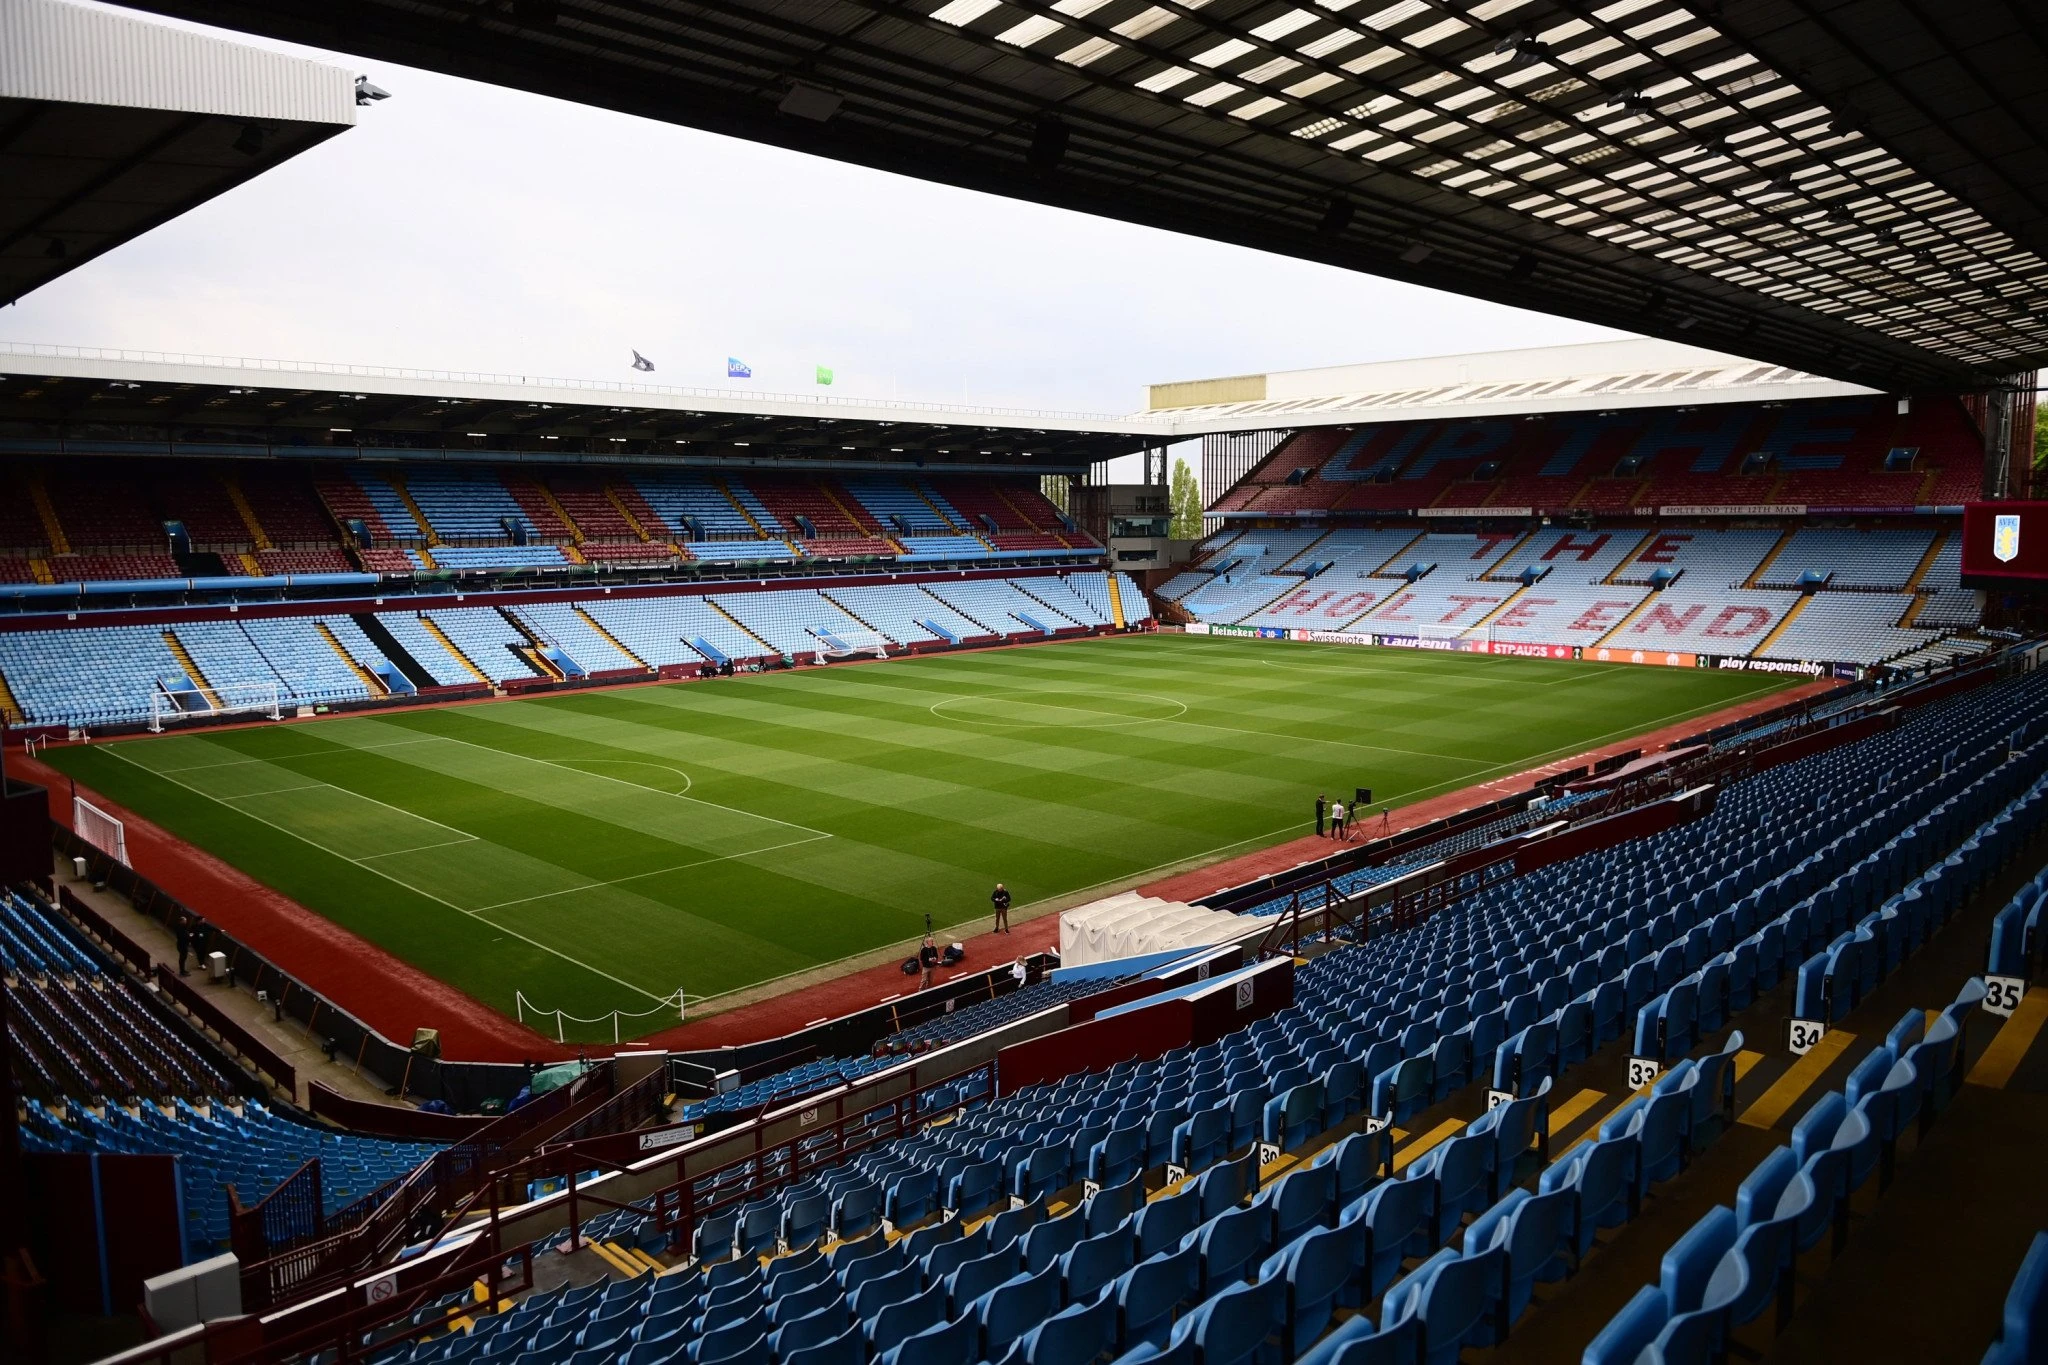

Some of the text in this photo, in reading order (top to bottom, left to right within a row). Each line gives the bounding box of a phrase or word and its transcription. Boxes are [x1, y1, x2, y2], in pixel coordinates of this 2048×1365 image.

[1452, 508, 1470, 516] THE
[1473, 507, 1523, 516] OBSESSION
[1634, 506, 1653, 516] 1888
[1666, 506, 1696, 514] HOLTE
[1700, 506, 1720, 514] END
[1724, 506, 1743, 514] THE
[1747, 505, 1771, 513] 12TH
[1775, 505, 1799, 513] MAN
[1470, 533, 1695, 564] THE
[1268, 587, 1775, 637] HOLTE END
[1212, 626, 1254, 638] Heineken
[1309, 631, 1364, 645] Swissquote
[1382, 637, 1455, 651] Laufenn
[1493, 643, 1548, 658] STRAUSS
[1719, 657, 1824, 676] play responsibly
[1986, 981, 2020, 1011] 35
[1792, 1025, 1819, 1049] 34
